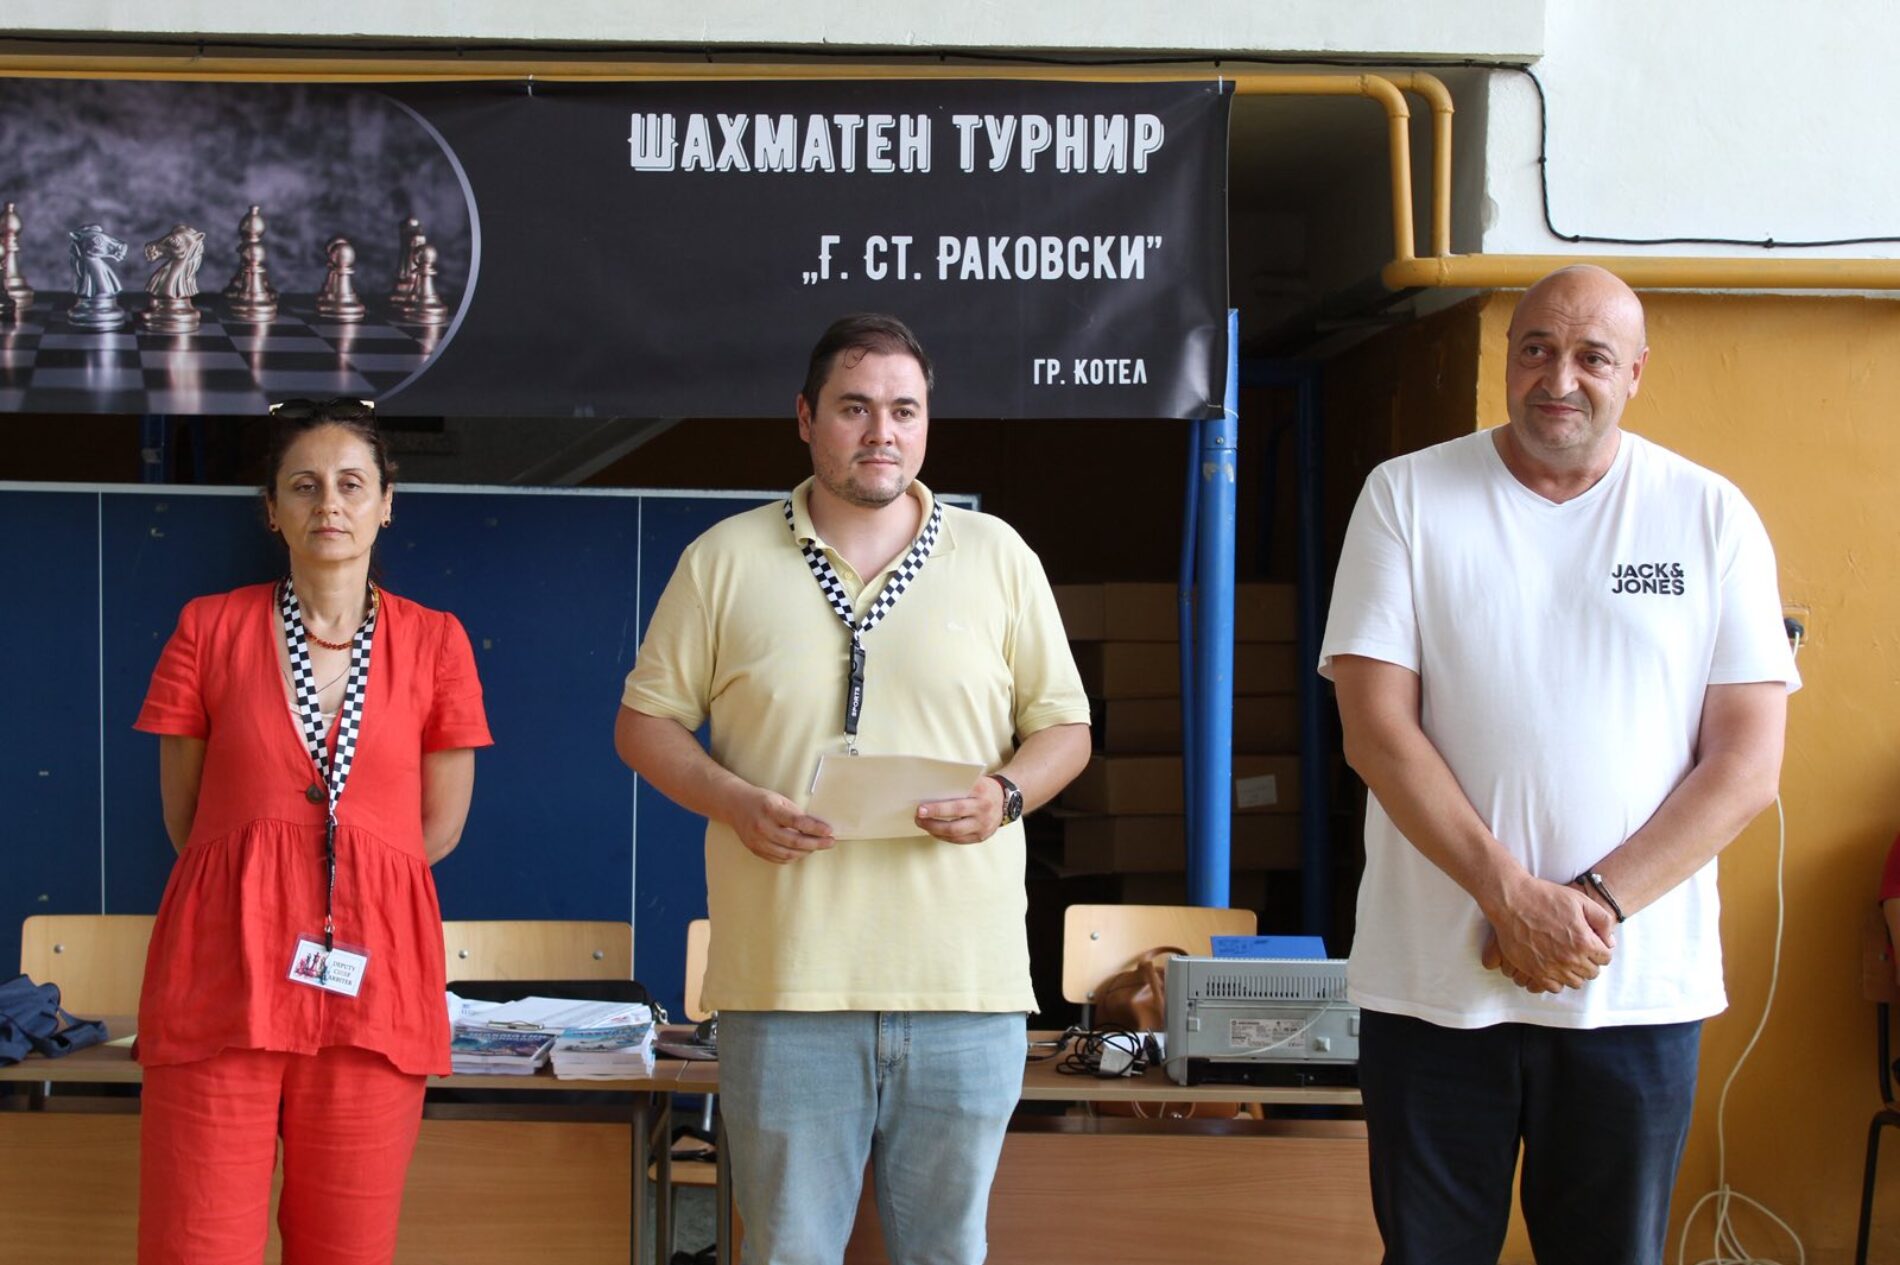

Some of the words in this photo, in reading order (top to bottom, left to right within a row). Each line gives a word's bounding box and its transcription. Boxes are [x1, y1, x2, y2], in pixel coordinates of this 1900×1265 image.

[628, 113, 931, 173] ШАХМАТЕН
[952, 114, 1165, 174] ТУРНИР
[863, 236, 921, 280] СТ.
[1033, 359, 1065, 385] ГР.
[1073, 359, 1147, 385] КОТЕЛ
[1611, 562, 1684, 579] JACK&
[1611, 579, 1685, 596] JONES
[333, 961, 355, 972] DEPUTY
